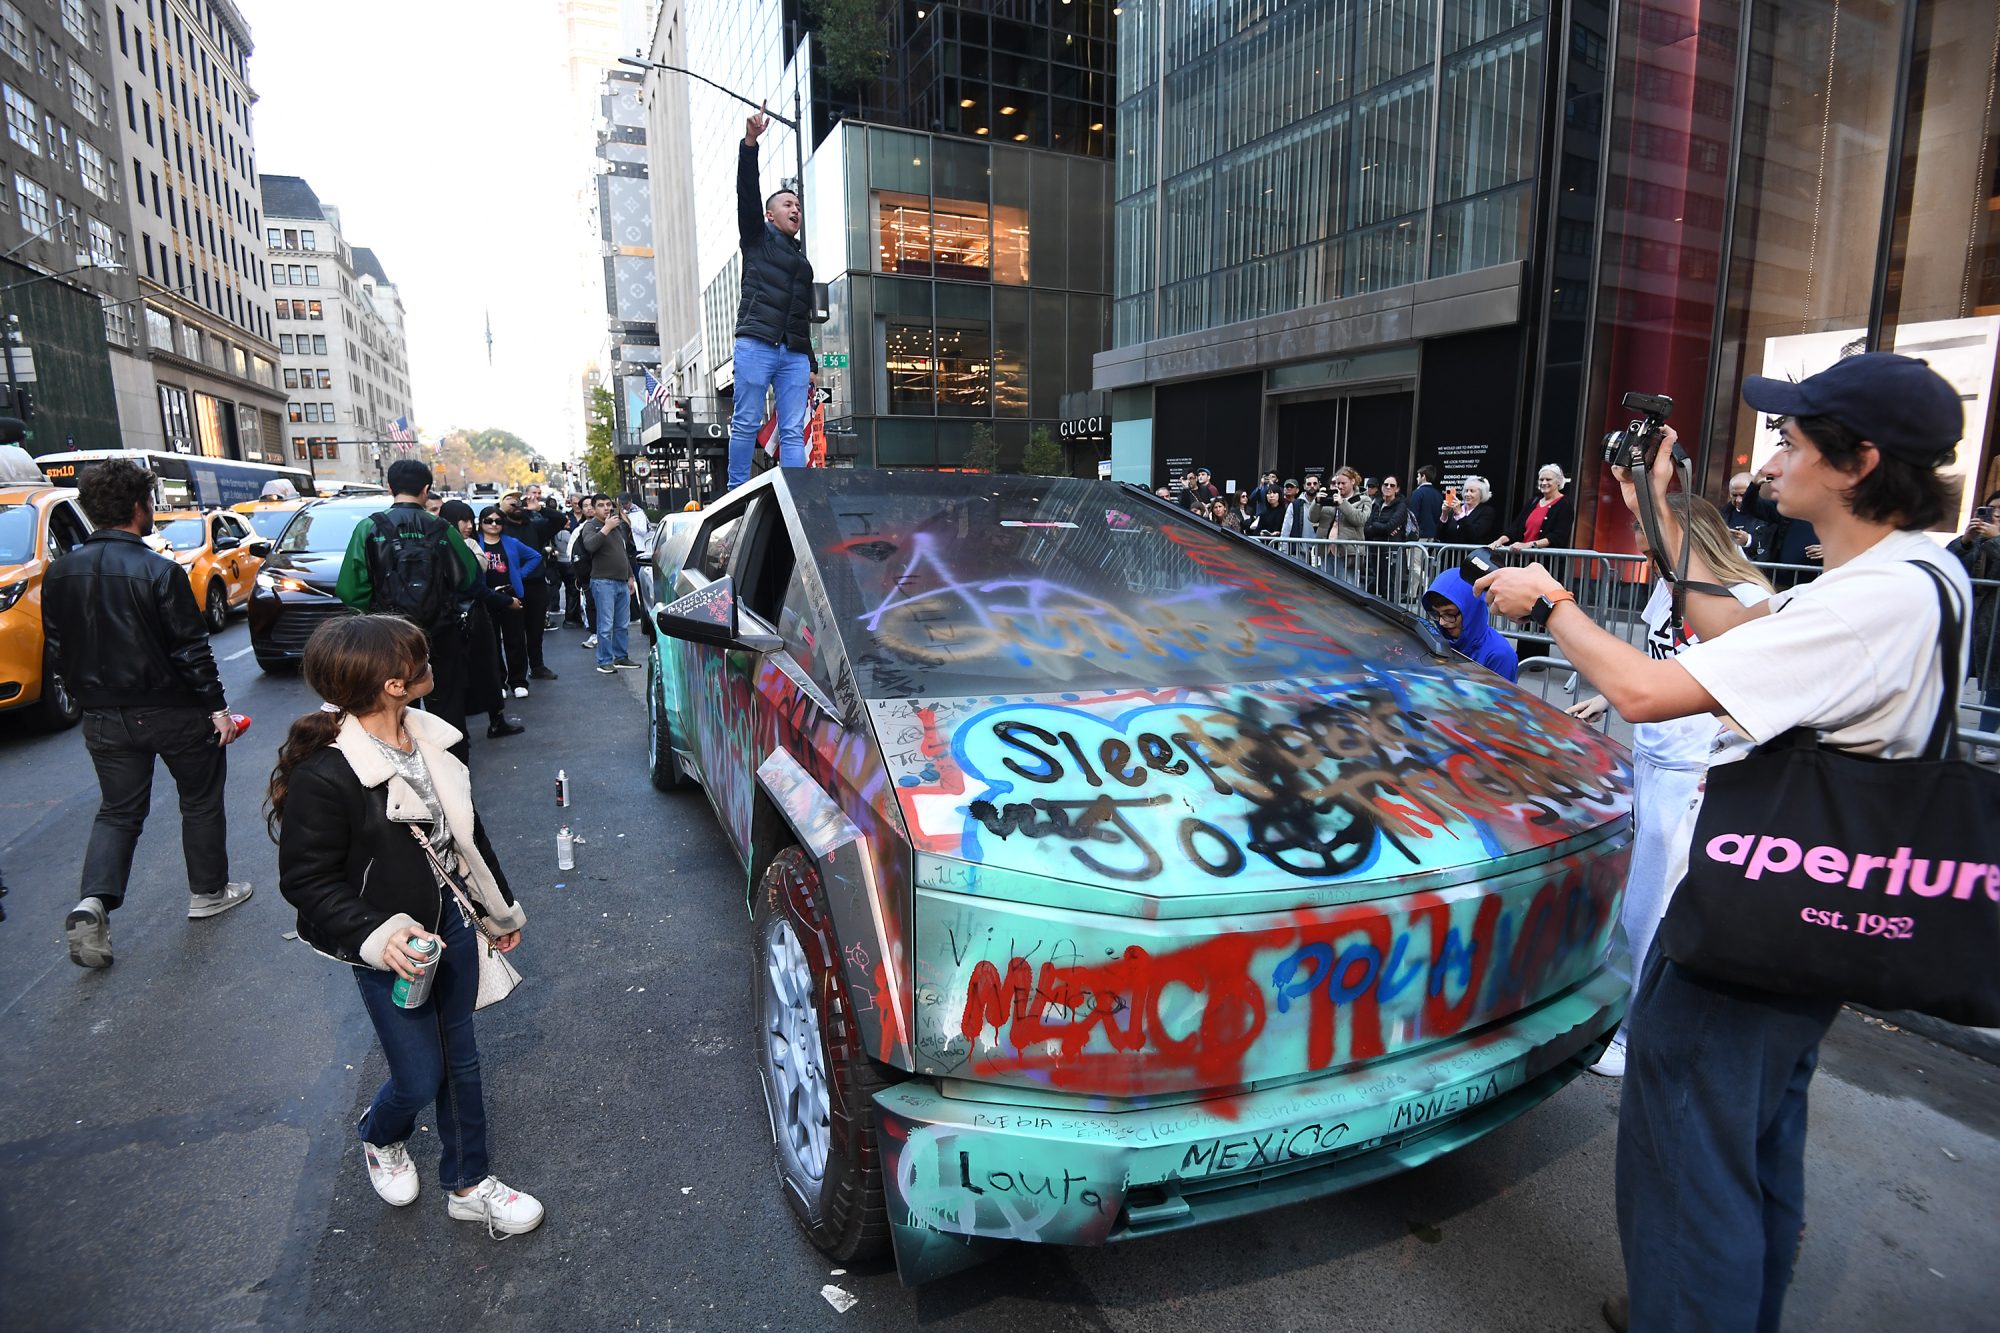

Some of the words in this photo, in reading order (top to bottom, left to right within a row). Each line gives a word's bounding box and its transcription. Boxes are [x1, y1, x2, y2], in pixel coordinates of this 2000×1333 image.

[822, 356, 828, 366] E
[829, 356, 839, 366] 56
[1327, 359, 1349, 378] 717
[1060, 417, 1102, 436] GUCCI
[1801, 905, 1849, 931] est.
[1854, 911, 1915, 940] 1952
[1393, 1074, 1499, 1129] MONEDA
